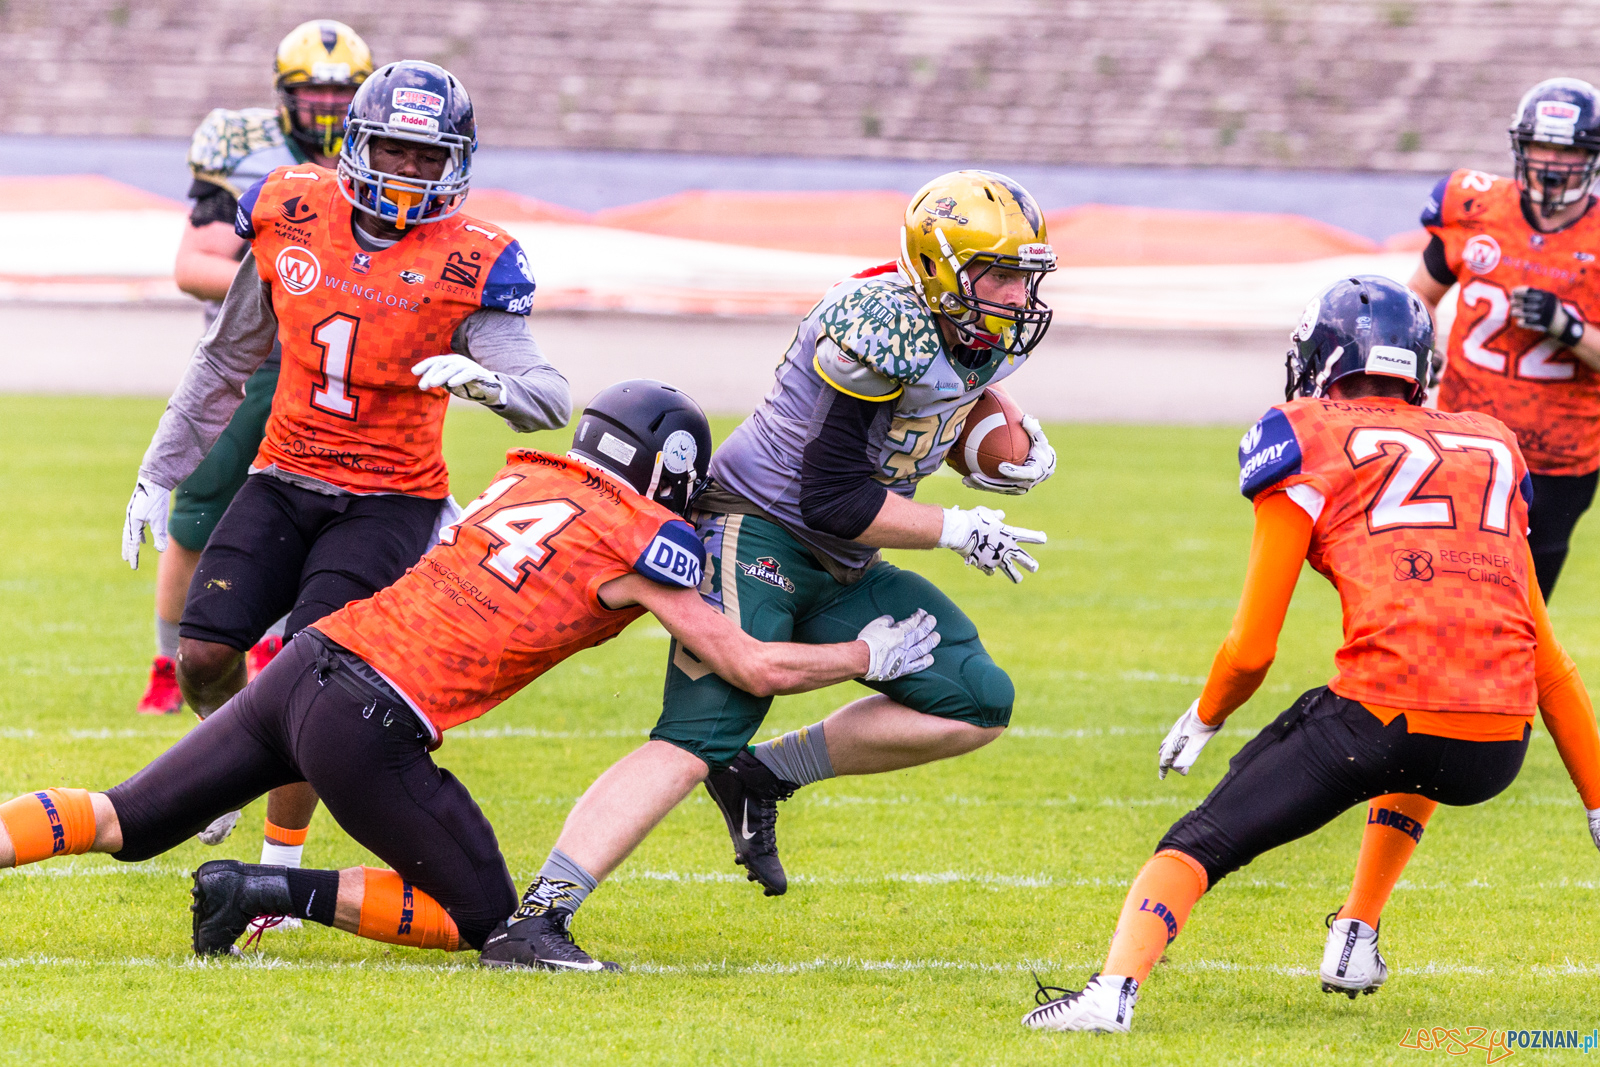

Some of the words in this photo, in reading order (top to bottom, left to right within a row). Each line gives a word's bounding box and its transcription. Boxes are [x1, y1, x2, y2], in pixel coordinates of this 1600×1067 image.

[401, 115, 428, 126] Riddell
[274, 221, 313, 238] WARMIA
[325, 275, 420, 313] WENGLORZ
[434, 281, 478, 299] OLSZTYN
[311, 311, 361, 422] 1
[1344, 427, 1516, 537] 27
[652, 542, 698, 586] DBK
[747, 565, 786, 588] ARMIA
[1467, 568, 1511, 587] Clinic
[428, 558, 499, 614] REGENERUM
[433, 580, 467, 607] Clinic
